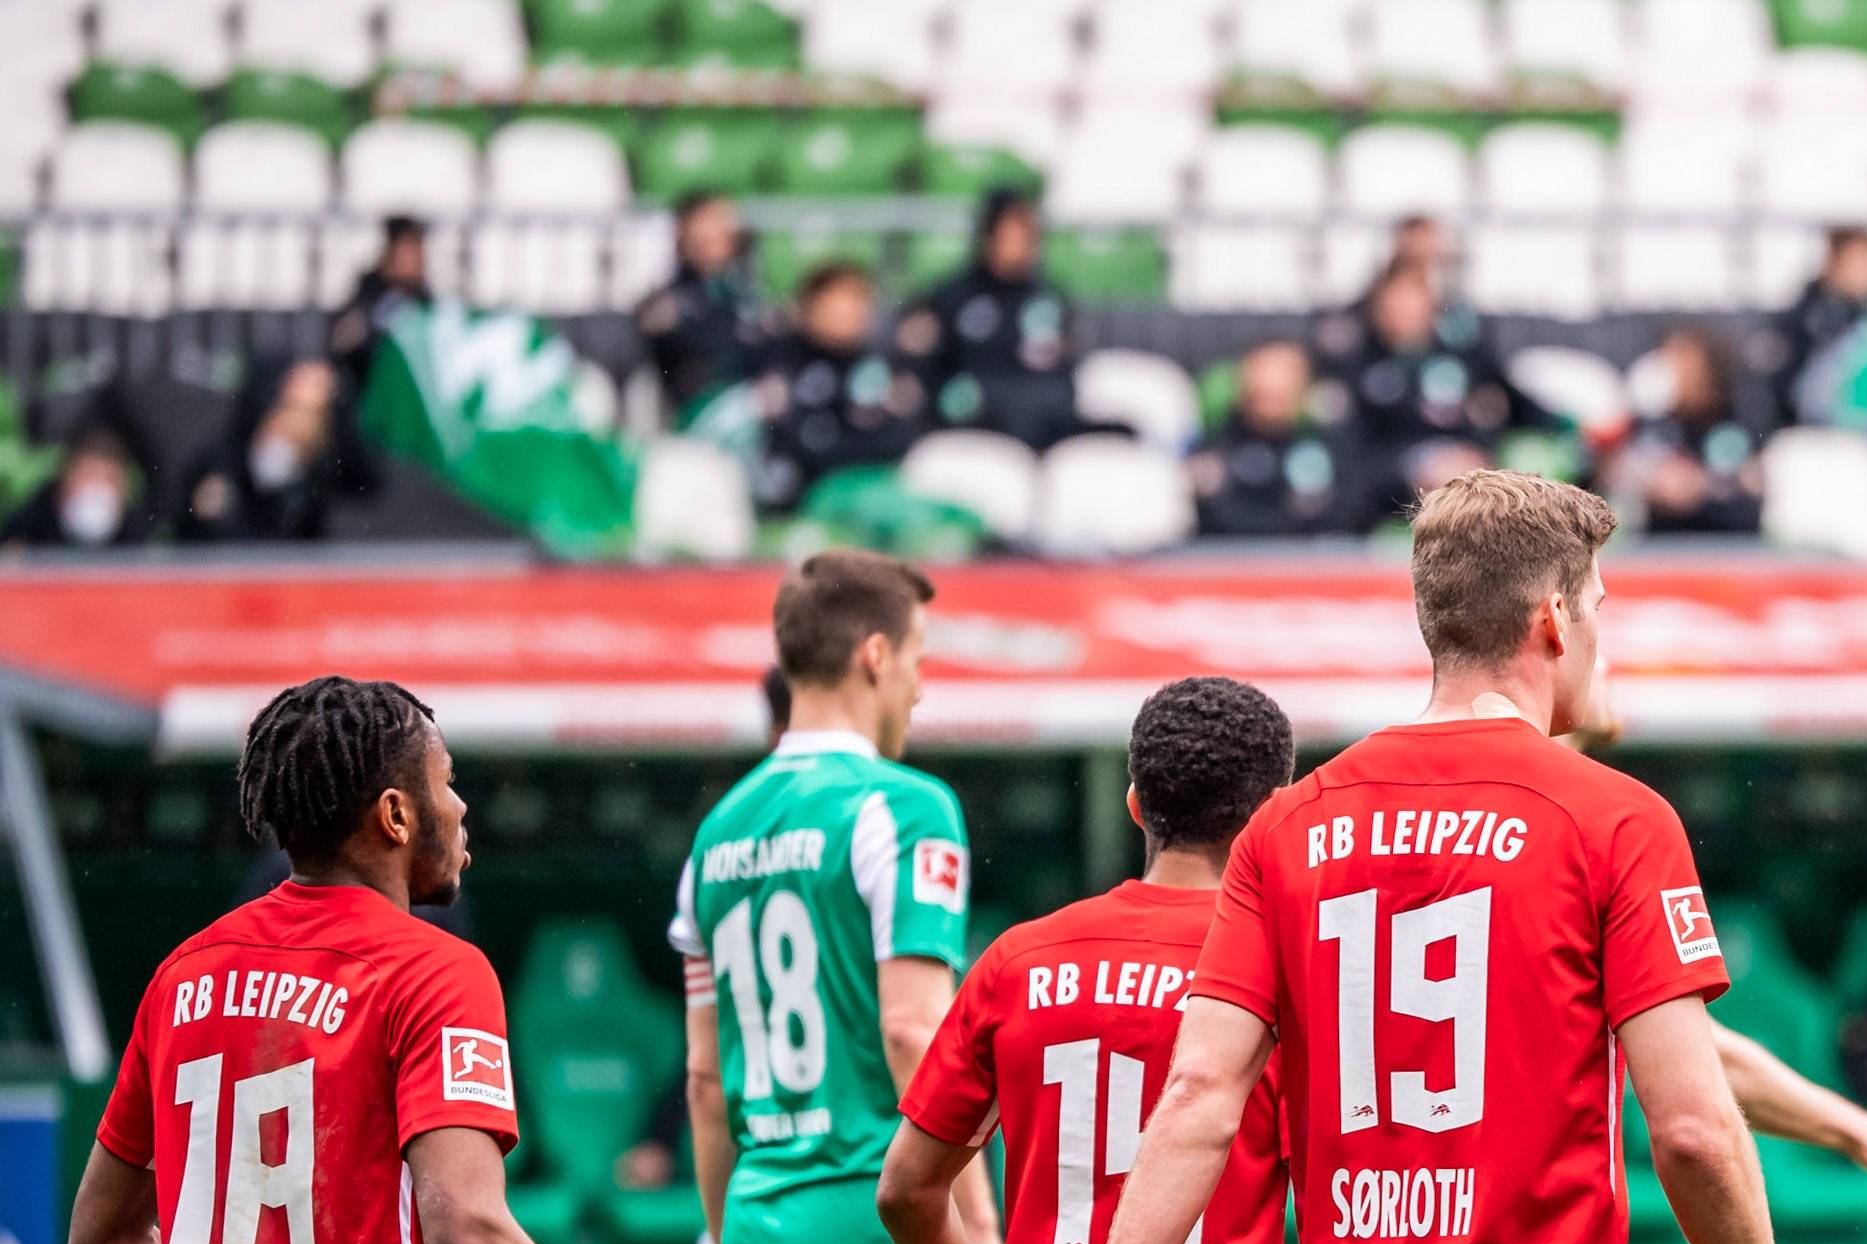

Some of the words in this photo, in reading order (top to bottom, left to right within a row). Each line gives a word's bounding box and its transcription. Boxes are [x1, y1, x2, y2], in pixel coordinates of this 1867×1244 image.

[1307, 815, 1354, 869] RB
[1370, 810, 1528, 862] LEIPZIG
[173, 975, 212, 1027] RB
[223, 970, 348, 1034] LEIPZIG
[713, 890, 827, 1100] 18
[1028, 962, 1080, 1010] RB
[1318, 885, 1492, 1135] 19
